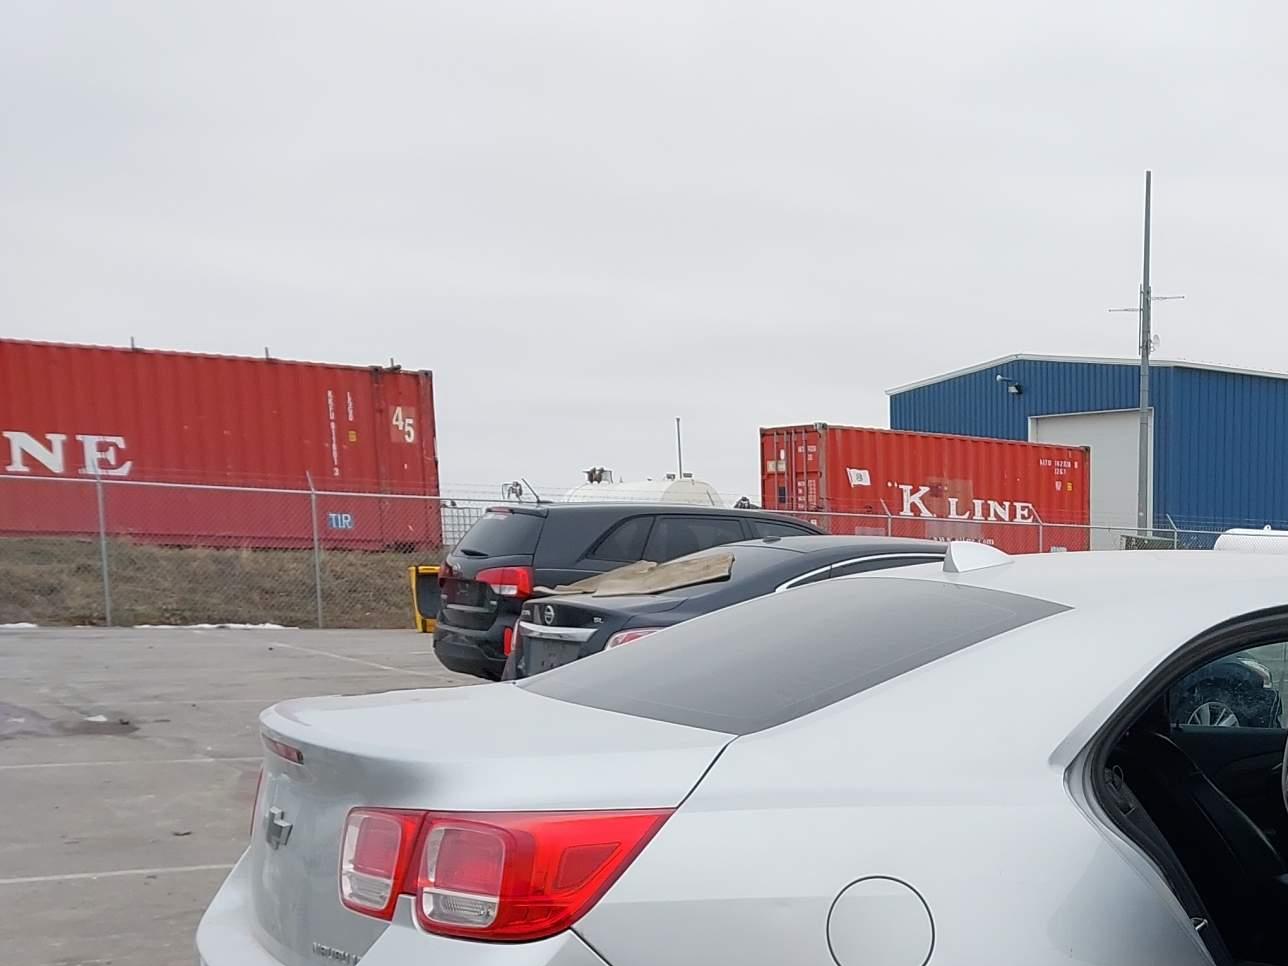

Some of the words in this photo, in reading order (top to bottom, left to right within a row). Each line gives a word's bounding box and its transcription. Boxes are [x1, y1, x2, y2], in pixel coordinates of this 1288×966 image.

[392, 405, 415, 443] 45
[328, 512, 353, 529] TIR
[948, 497, 1034, 523] LINE
